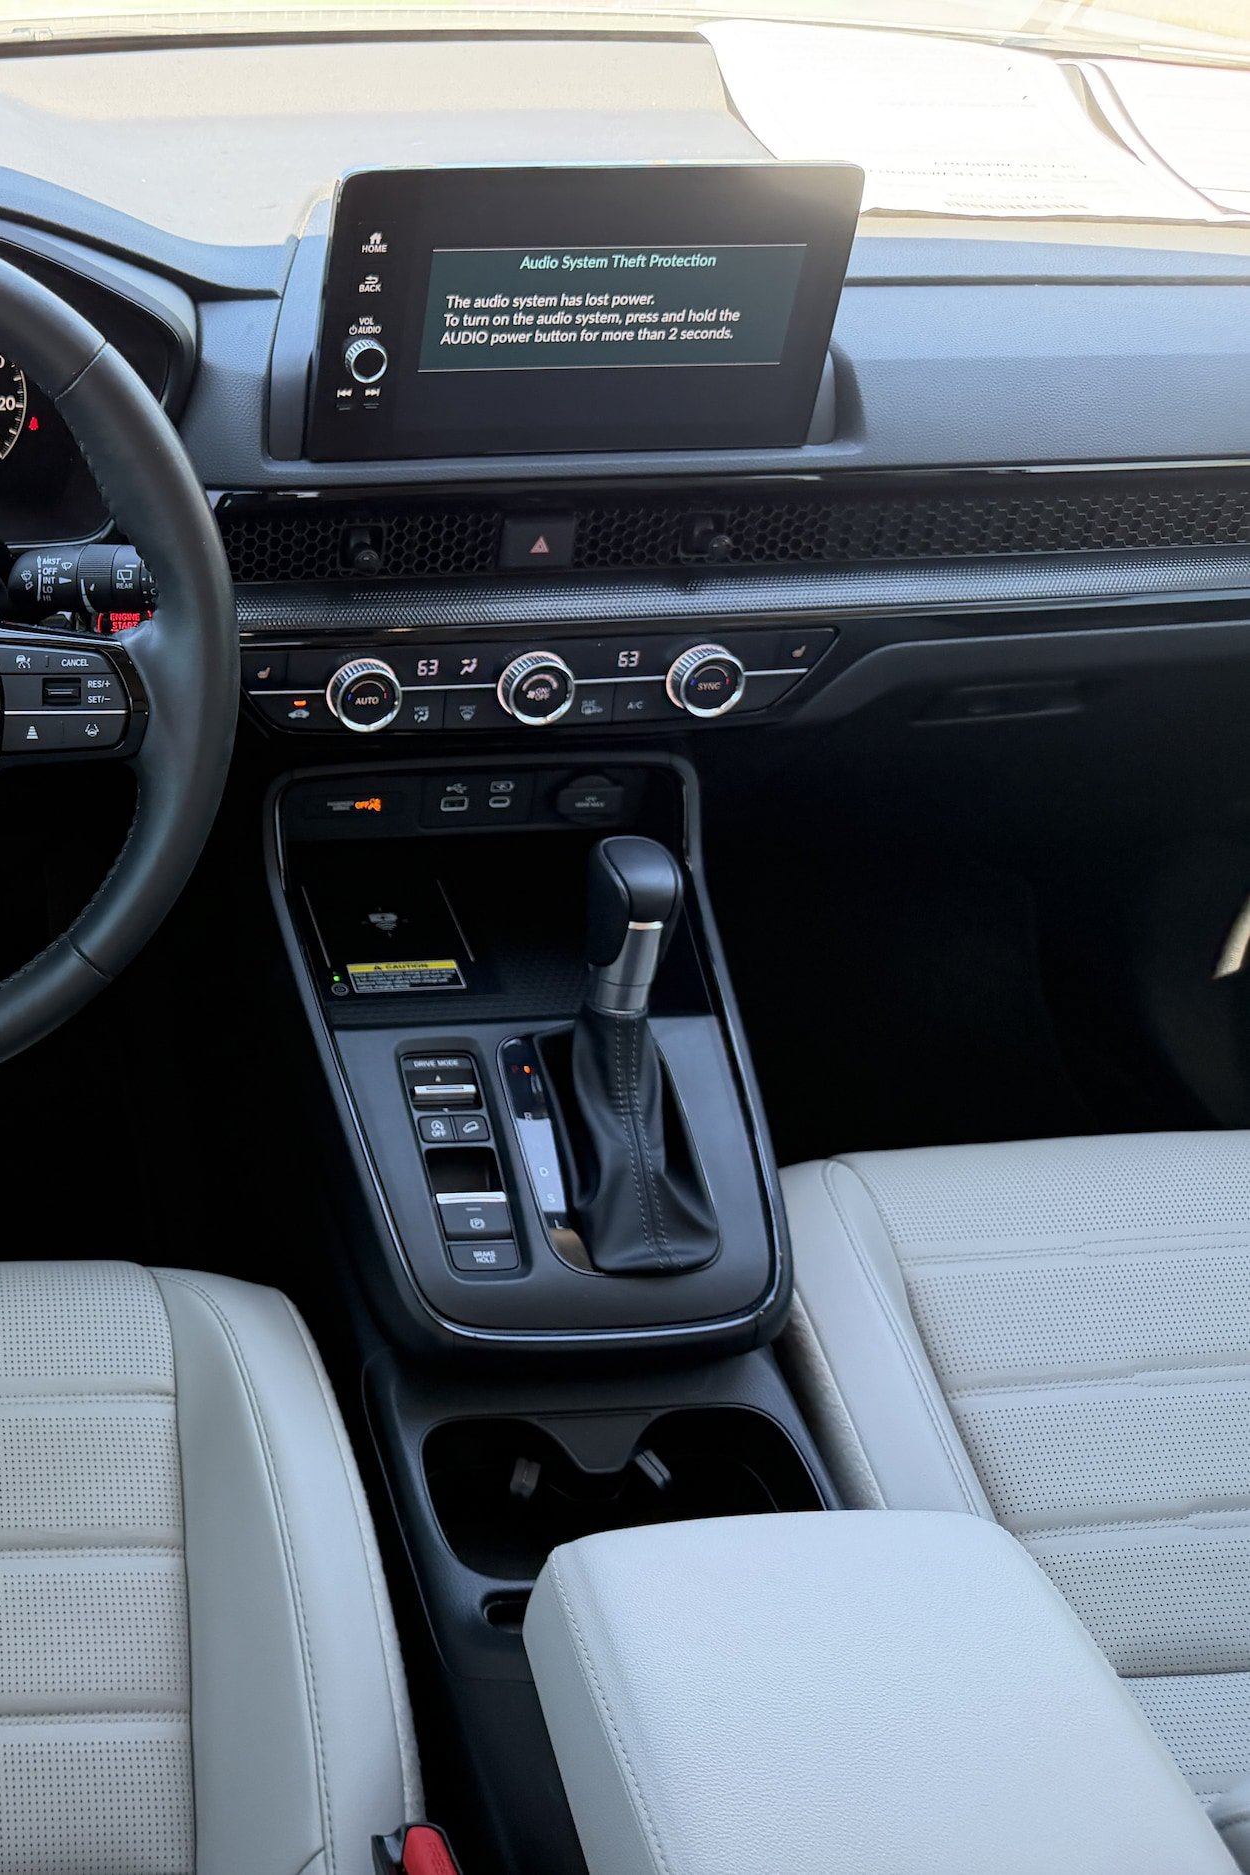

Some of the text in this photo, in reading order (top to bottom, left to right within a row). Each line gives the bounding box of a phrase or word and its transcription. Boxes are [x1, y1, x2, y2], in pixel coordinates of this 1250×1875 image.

[361, 244, 388, 253] HOME
[520, 253, 717, 271] Audio System Theft Protection
[359, 284, 382, 293] BACK
[446, 293, 655, 310] The audio system has lost power.
[359, 317, 374, 325] VOL
[444, 308, 741, 327] To turn on the audio system, press and hold the
[357, 325, 382, 334] AUDIO
[440, 326, 734, 347] AUDIO power button for more than 2 seconds.
[42, 557, 61, 565] MIST
[42, 567, 57, 575] OFF
[42, 577, 55, 585] INT
[42, 586, 53, 594] LO
[116, 582, 133, 590] REAR
[110, 613, 140, 621] ENGINE
[61, 658, 89, 667] CANCEL
[617, 651, 639, 667] 63
[417, 659, 439, 676] 63
[697, 682, 722, 690] SYNC
[354, 696, 379, 705] AUTO
[627, 701, 643, 709] A/C
[413, 1059, 459, 1068] DRIVE MODE
[431, 1129, 447, 1137] OFF
[539, 1166, 549, 1177] D
[547, 1193, 556, 1203] S
[554, 1219, 564, 1229] L
